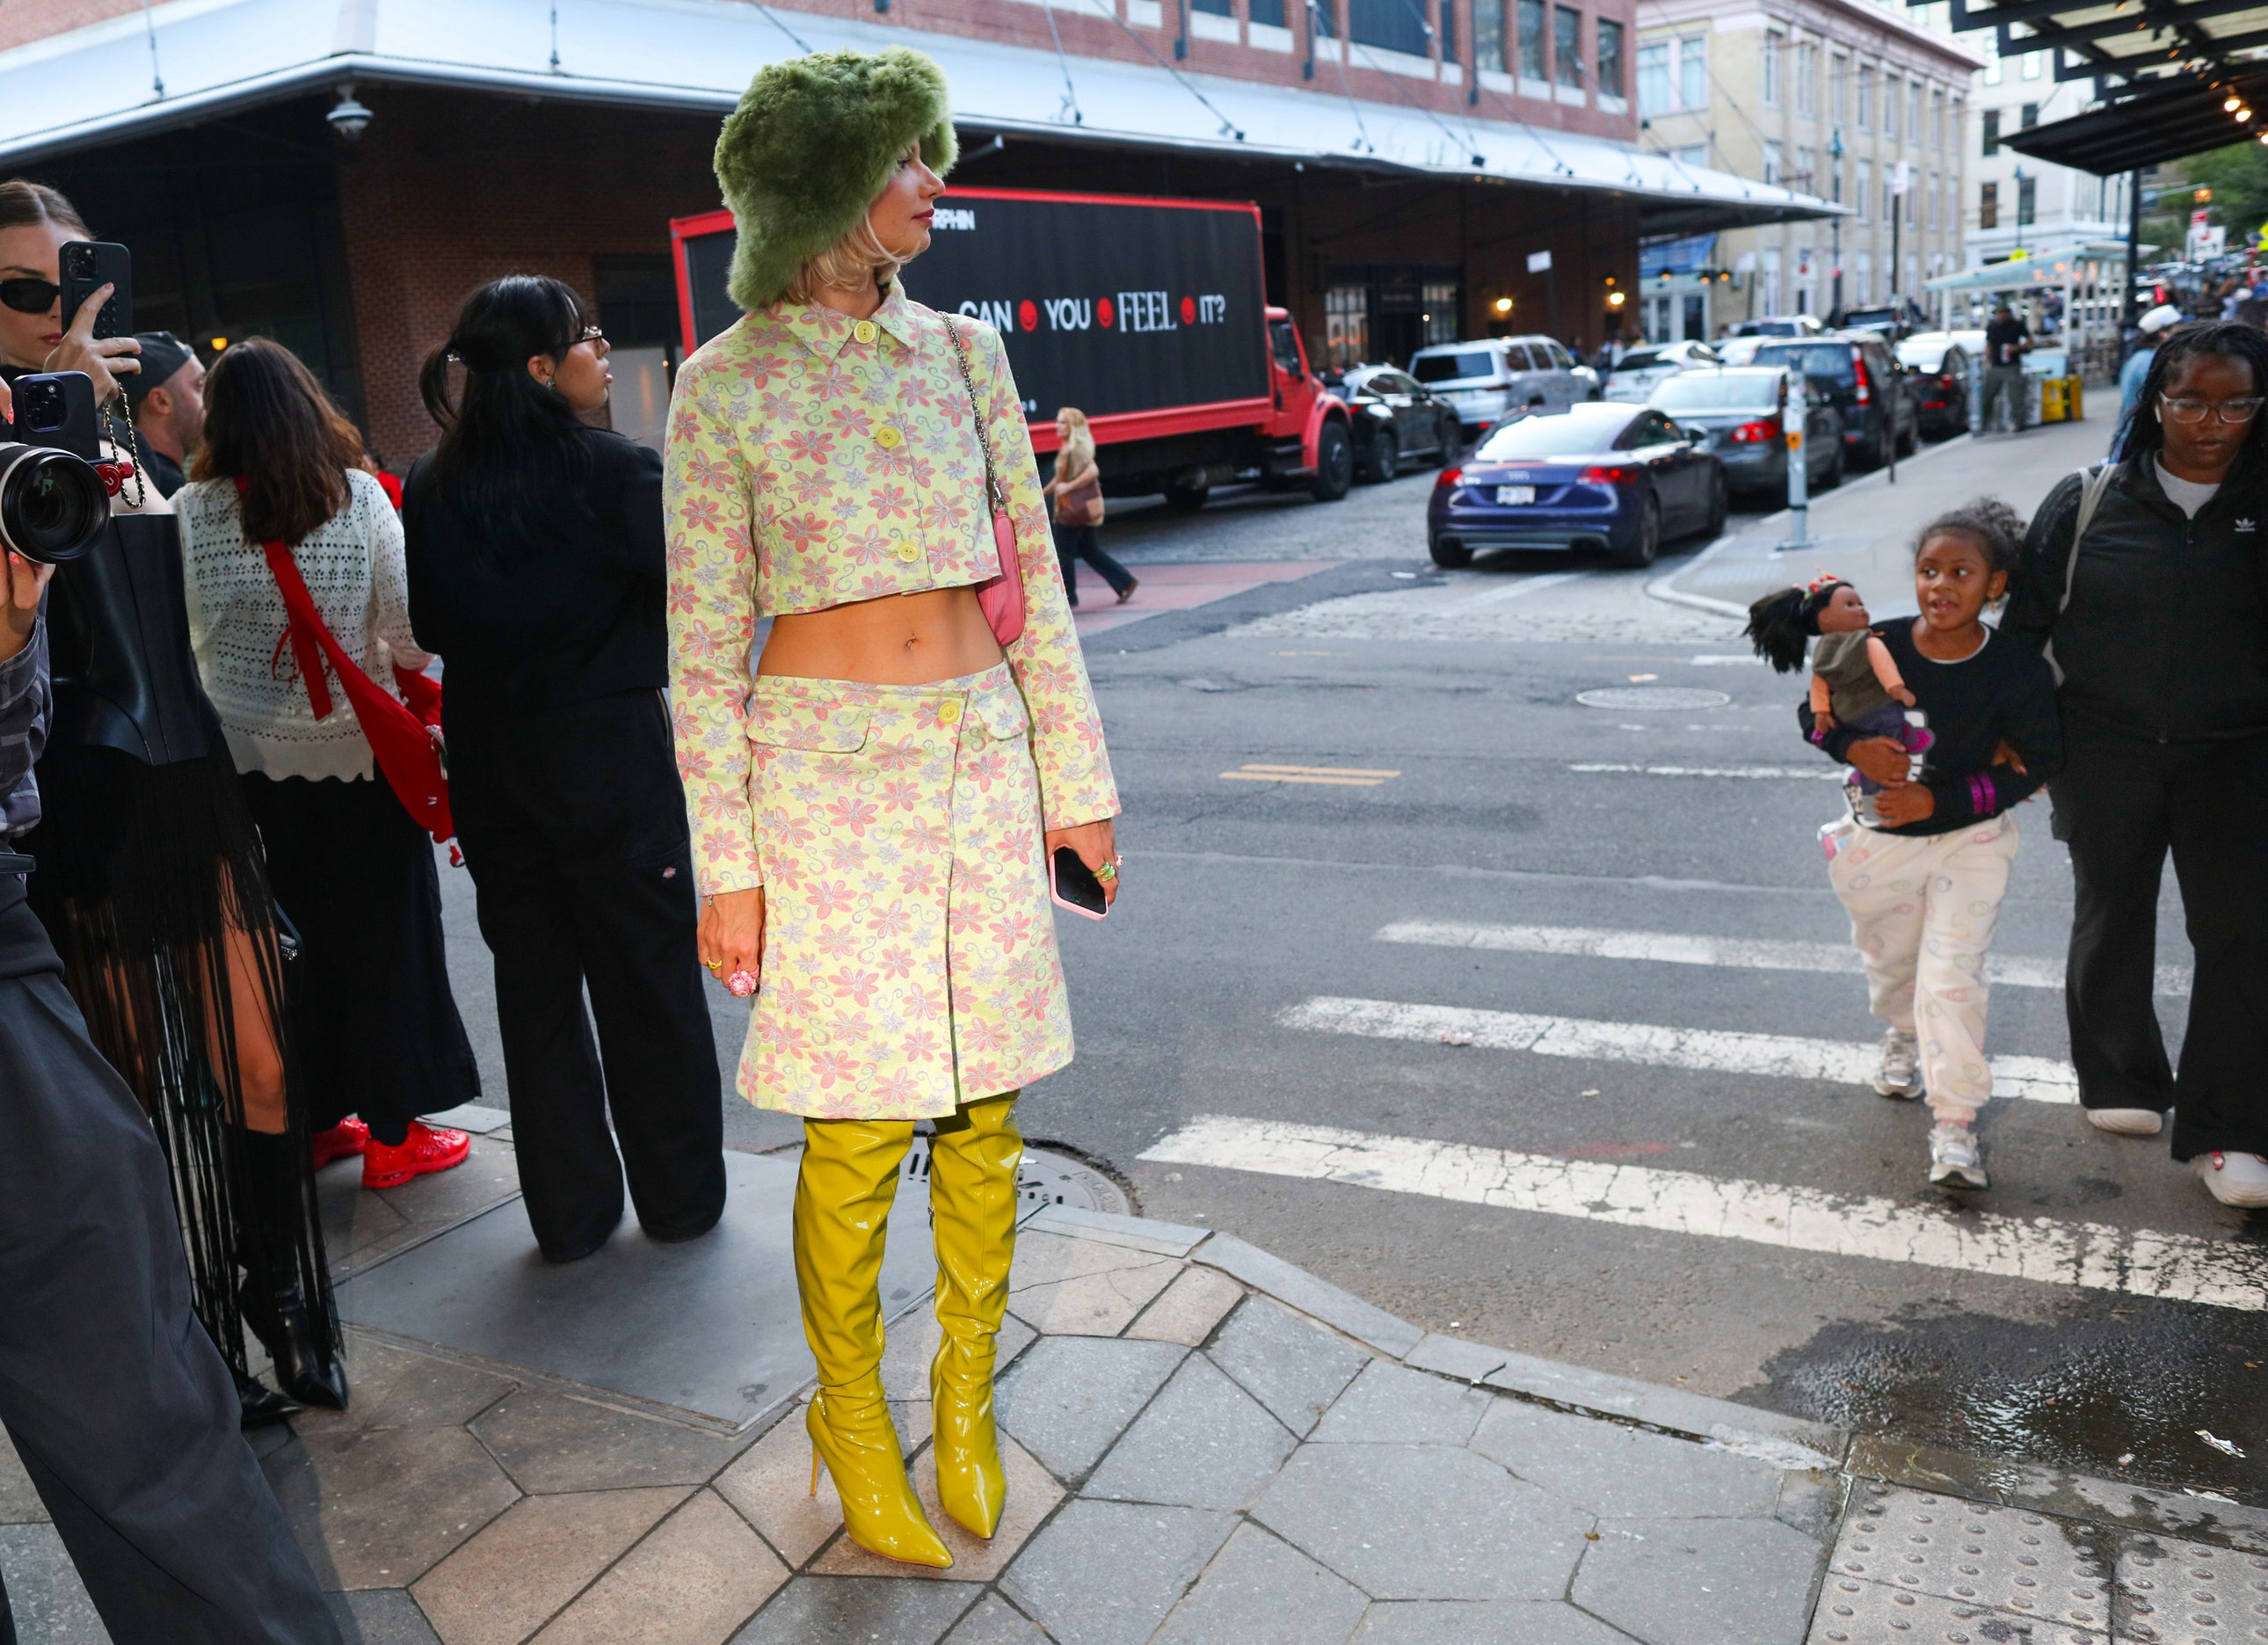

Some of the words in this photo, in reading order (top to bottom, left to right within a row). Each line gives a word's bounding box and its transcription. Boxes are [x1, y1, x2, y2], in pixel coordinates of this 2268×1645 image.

[933, 208, 976, 230] RPHIN
[958, 300, 1013, 332] CAN
[1044, 298, 1091, 331] YOU
[1117, 291, 1177, 332] FEEL
[1199, 294, 1226, 324] IT?
